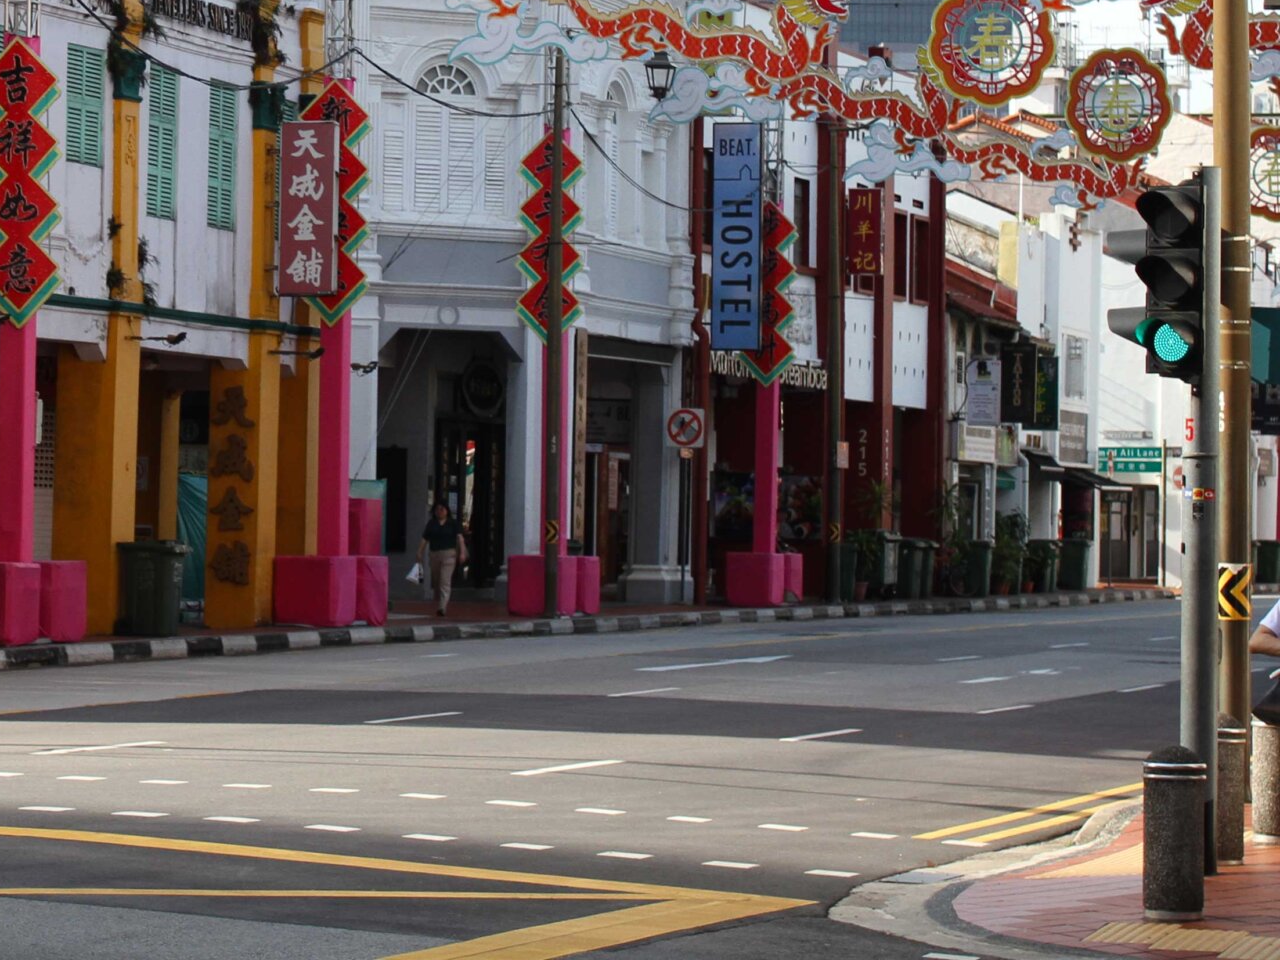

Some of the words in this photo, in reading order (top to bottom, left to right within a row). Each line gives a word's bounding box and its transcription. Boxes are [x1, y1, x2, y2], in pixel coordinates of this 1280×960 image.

[970, 12, 1012, 68] 春
[1100, 76, 1137, 128] 春
[720, 138, 756, 158] BEAT.
[720, 200, 754, 335] HOSTEL
